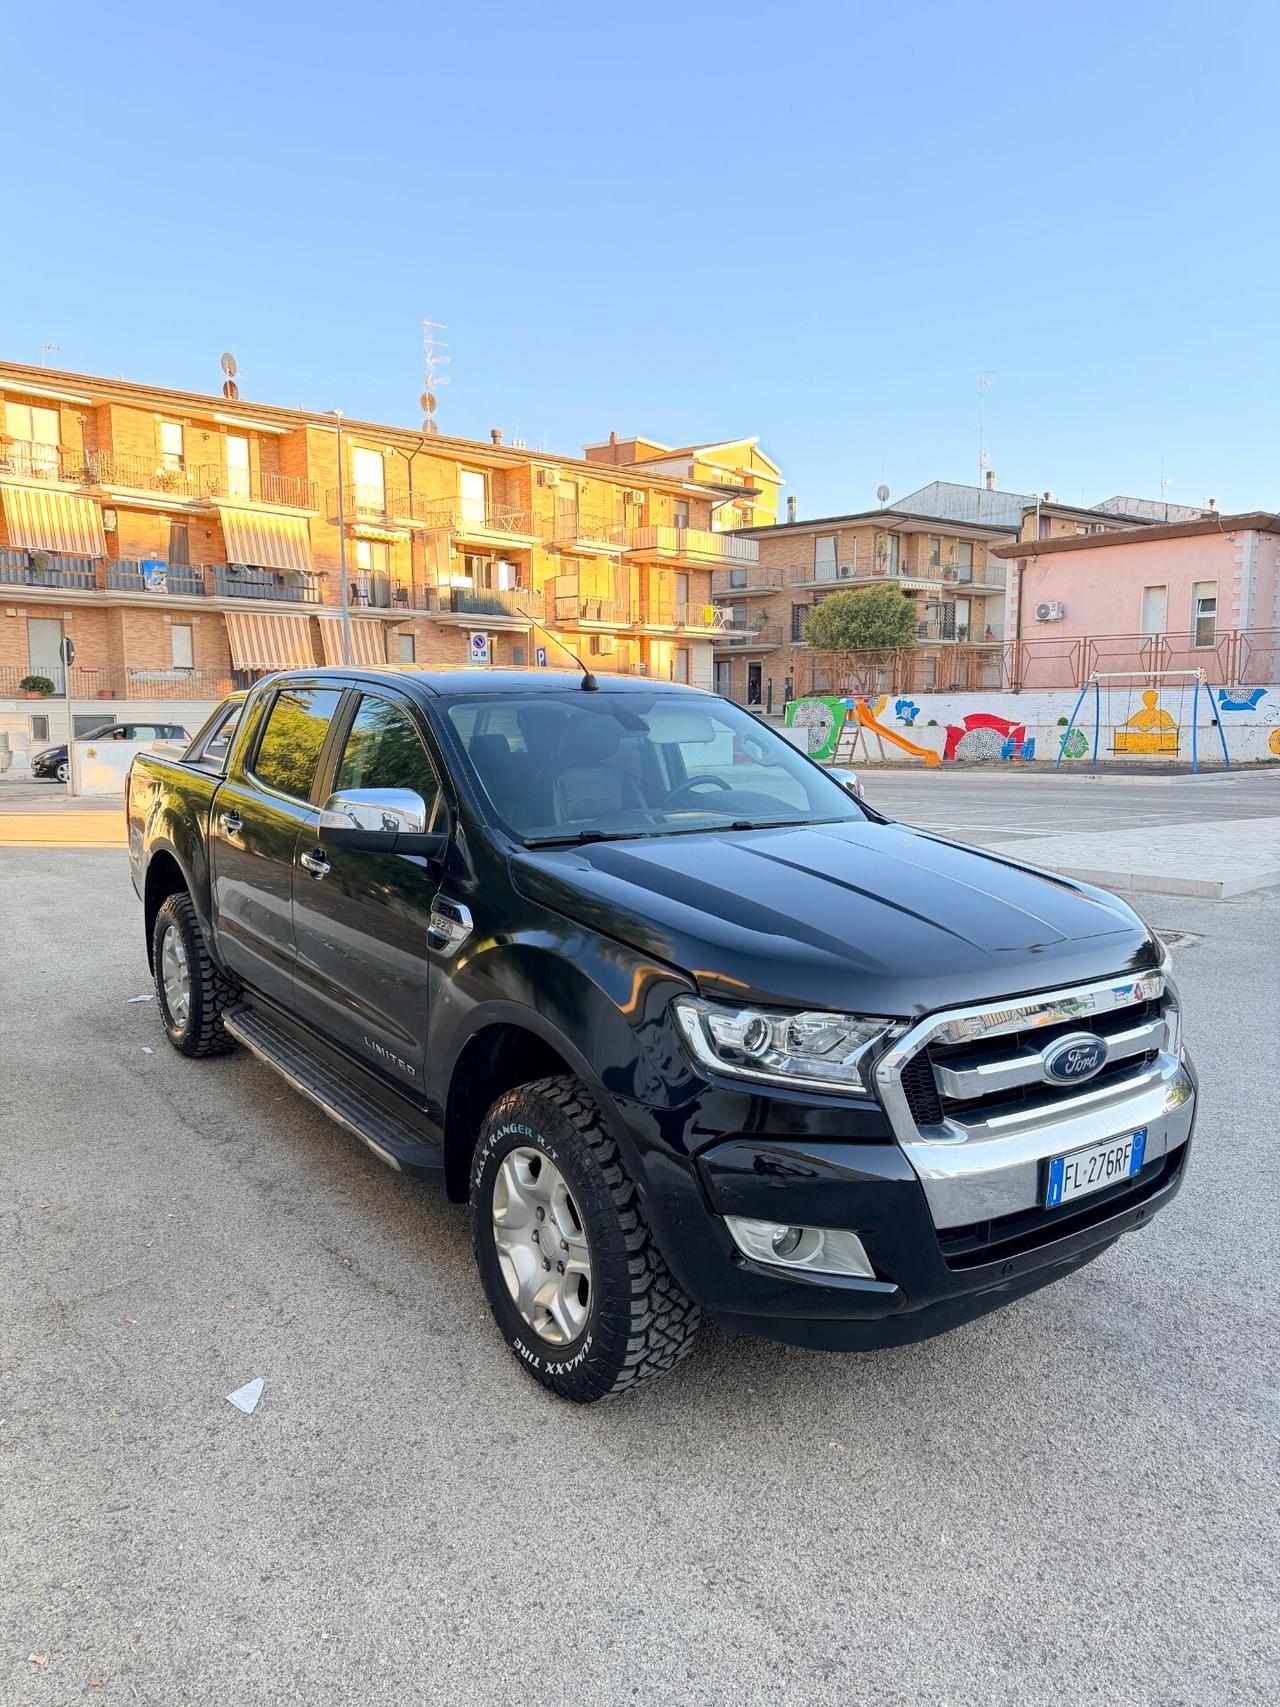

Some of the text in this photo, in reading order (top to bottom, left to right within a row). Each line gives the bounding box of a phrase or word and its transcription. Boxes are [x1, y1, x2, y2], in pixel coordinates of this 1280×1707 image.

[537, 649, 545, 667] P
[363, 1036, 416, 1076] LIMITED
[1065, 1047, 1099, 1074] Ford
[475, 1123, 559, 1188] MAX RANGER R/T
[513, 1331, 593, 1375] SUMAXX TIRE
